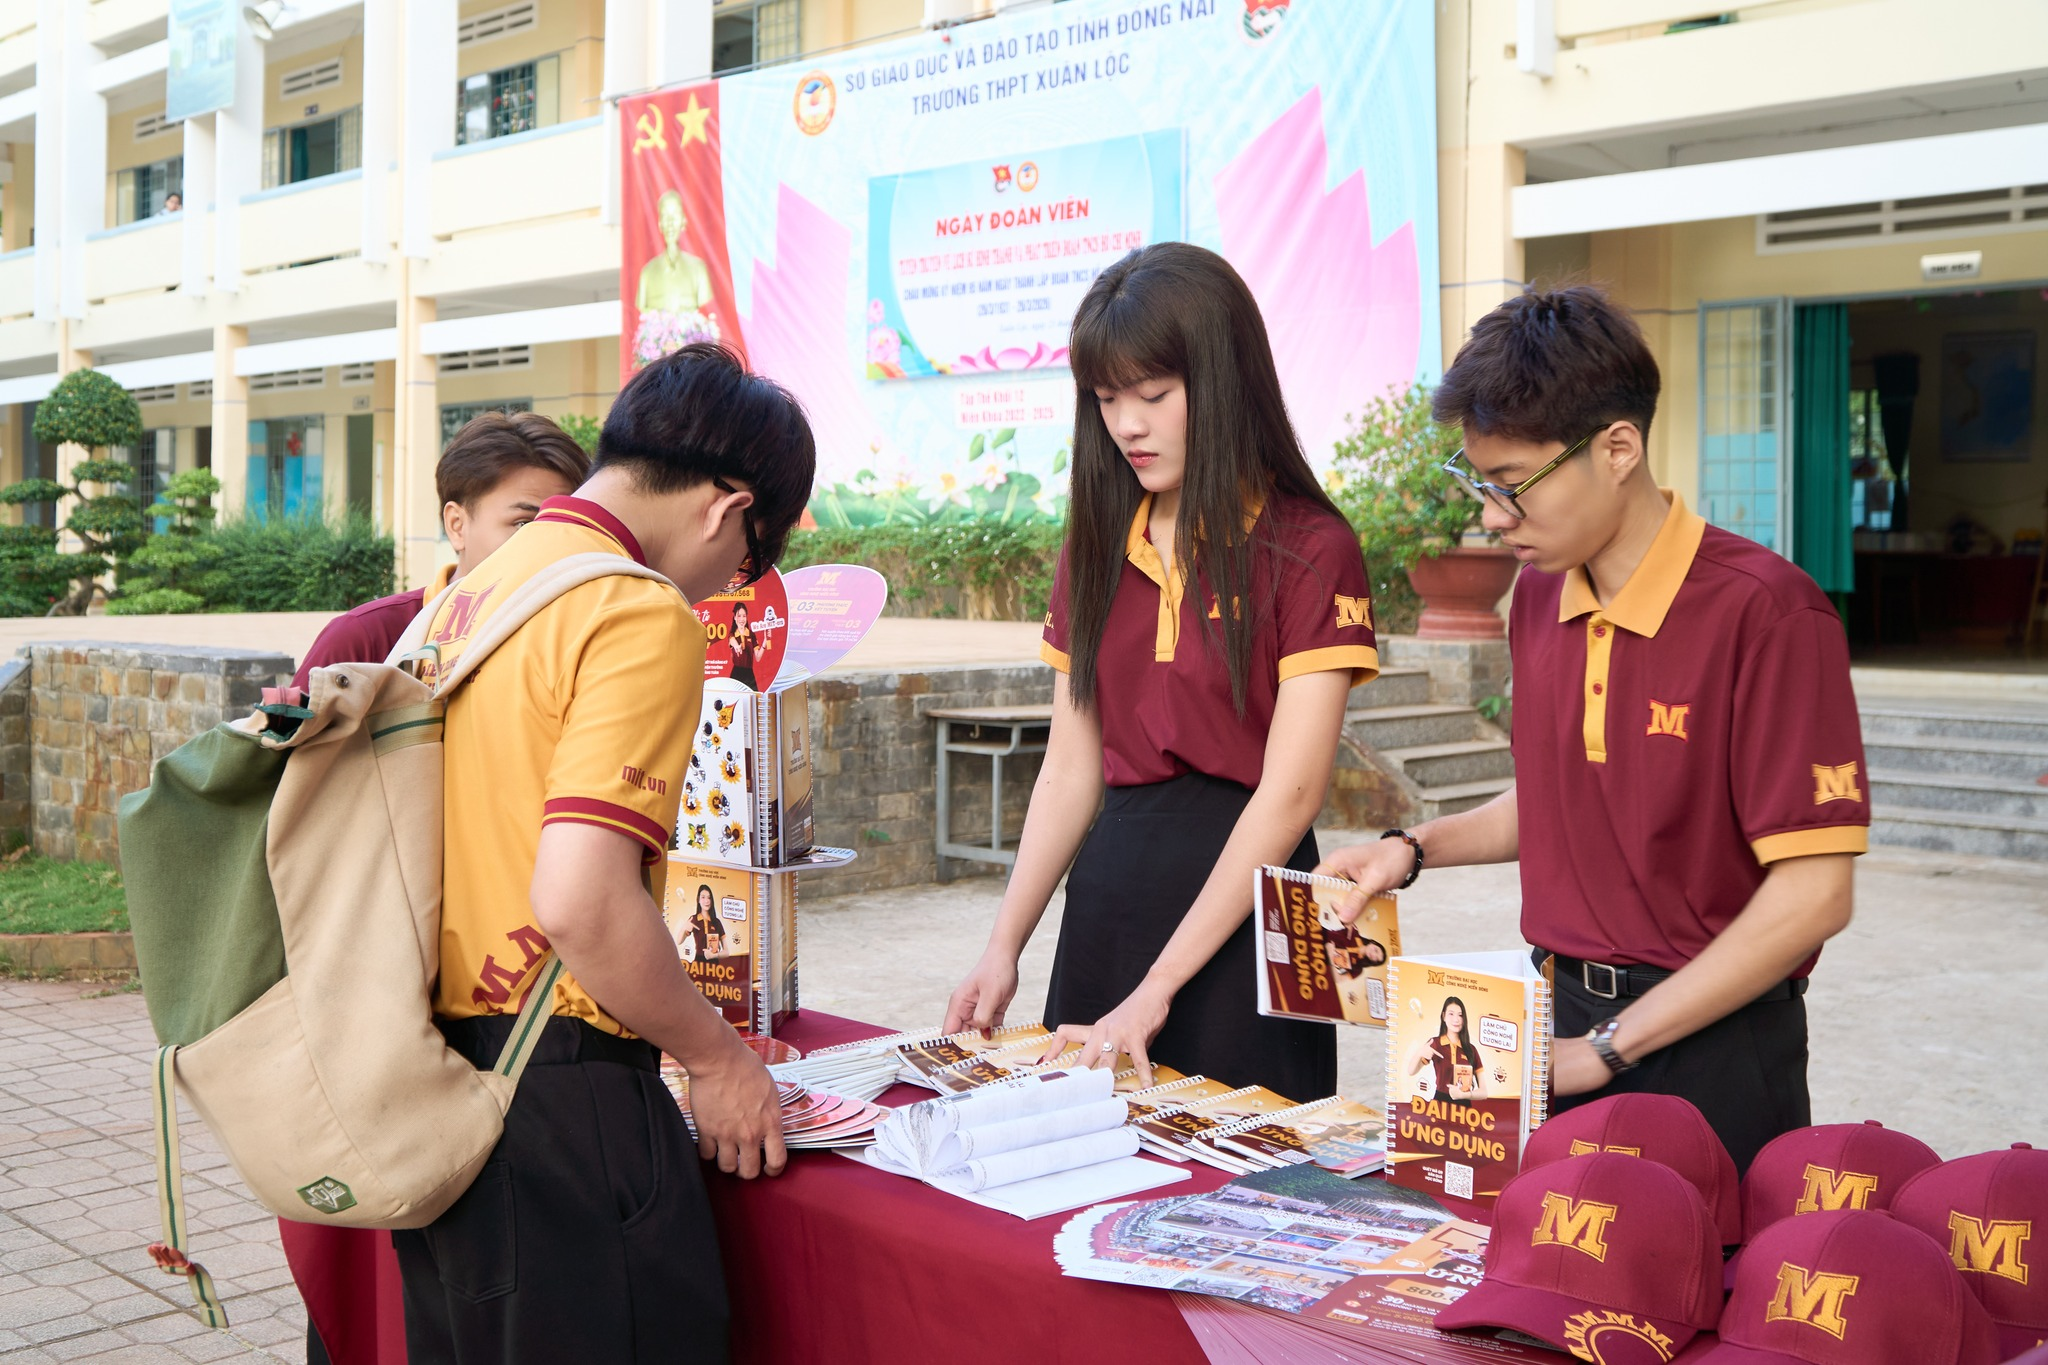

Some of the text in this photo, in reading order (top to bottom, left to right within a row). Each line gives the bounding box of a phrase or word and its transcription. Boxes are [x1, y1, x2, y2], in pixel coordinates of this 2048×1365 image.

[915, 53, 949, 80] DỤC
[955, 43, 976, 70] VÀ
[983, 37, 1018, 64] ĐÀO
[1025, 29, 1058, 58] TẠO
[912, 51, 1129, 115] TRƯỜNG THPT XUÂN LỘC
[936, 195, 1090, 237] NGÀY ĐOÀN VIÊN
[797, 601, 815, 612] 03
[803, 619, 819, 629] 02
[845, 620, 862, 629] 03
[1335, 594, 1373, 631] M
[1646, 699, 1690, 742] M
[1812, 761, 1862, 805] M
[1290, 887, 1313, 1000] ỨNG DỤNG
[1306, 902, 1329, 991] ĐẠI HỌC
[706, 964, 735, 982] HỌC
[706, 983, 742, 1002] DỤNG
[1428, 970, 1445, 986] M
[1411, 1094, 1496, 1132] ĐẠI HỌC
[1400, 1115, 1506, 1162] ỨNG DỤNG
[1796, 1163, 1879, 1217] M
[1531, 1190, 1618, 1264] M
[1950, 1210, 2032, 1286] M
[1765, 1260, 1860, 1341] M
